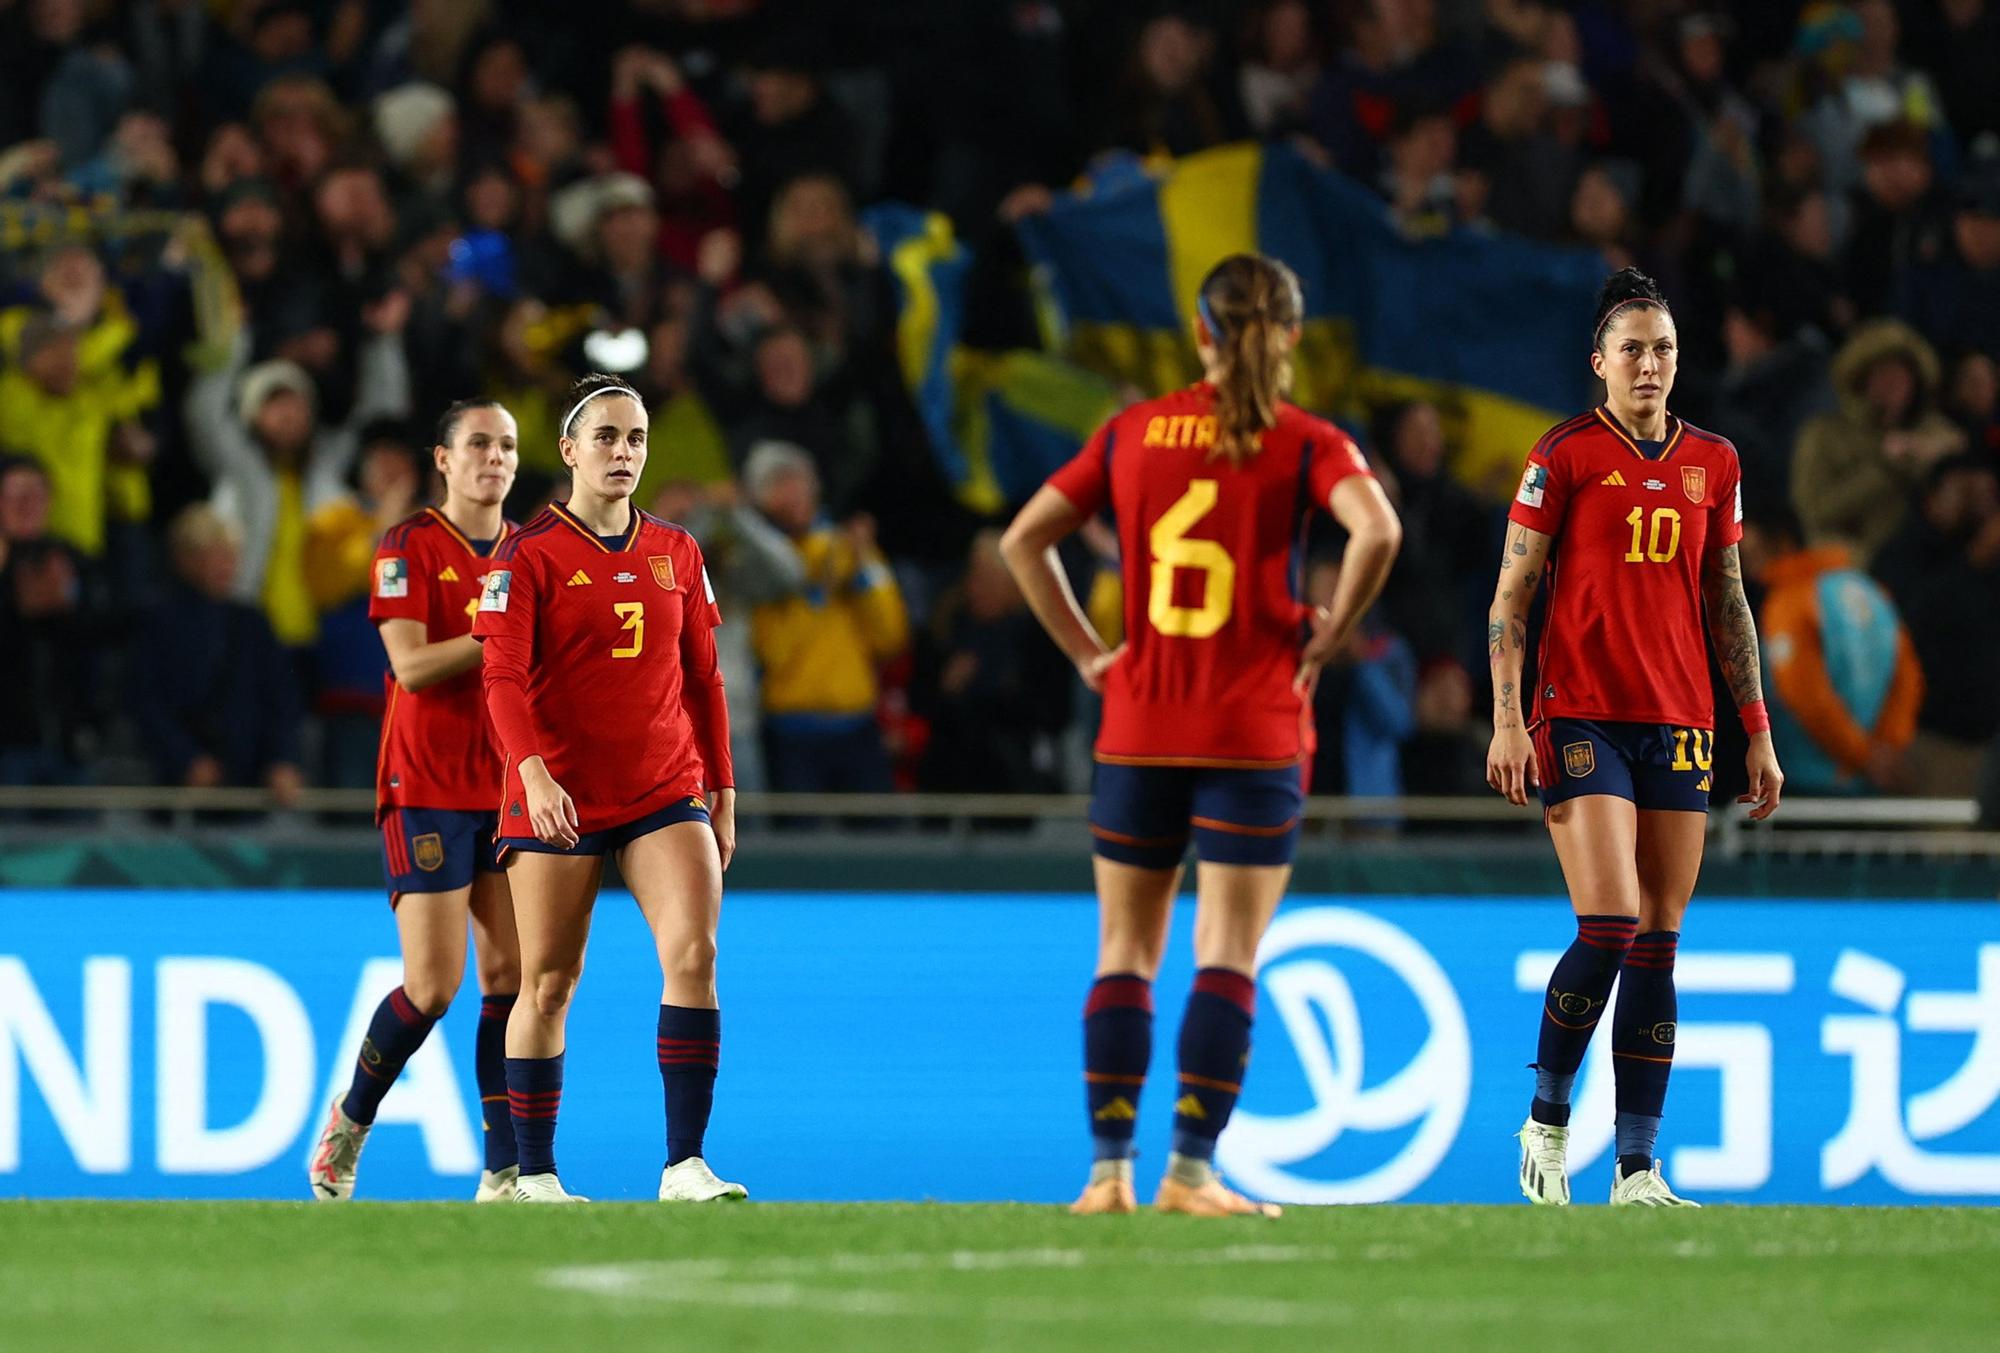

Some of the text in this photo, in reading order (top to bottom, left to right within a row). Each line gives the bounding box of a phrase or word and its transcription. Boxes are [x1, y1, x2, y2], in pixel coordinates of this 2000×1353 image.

[1143, 415, 1262, 450] AITA
[1149, 478, 1235, 639] 6
[1624, 506, 1681, 563] 10
[611, 602, 645, 659] 3
[1672, 729, 1713, 770] 10
